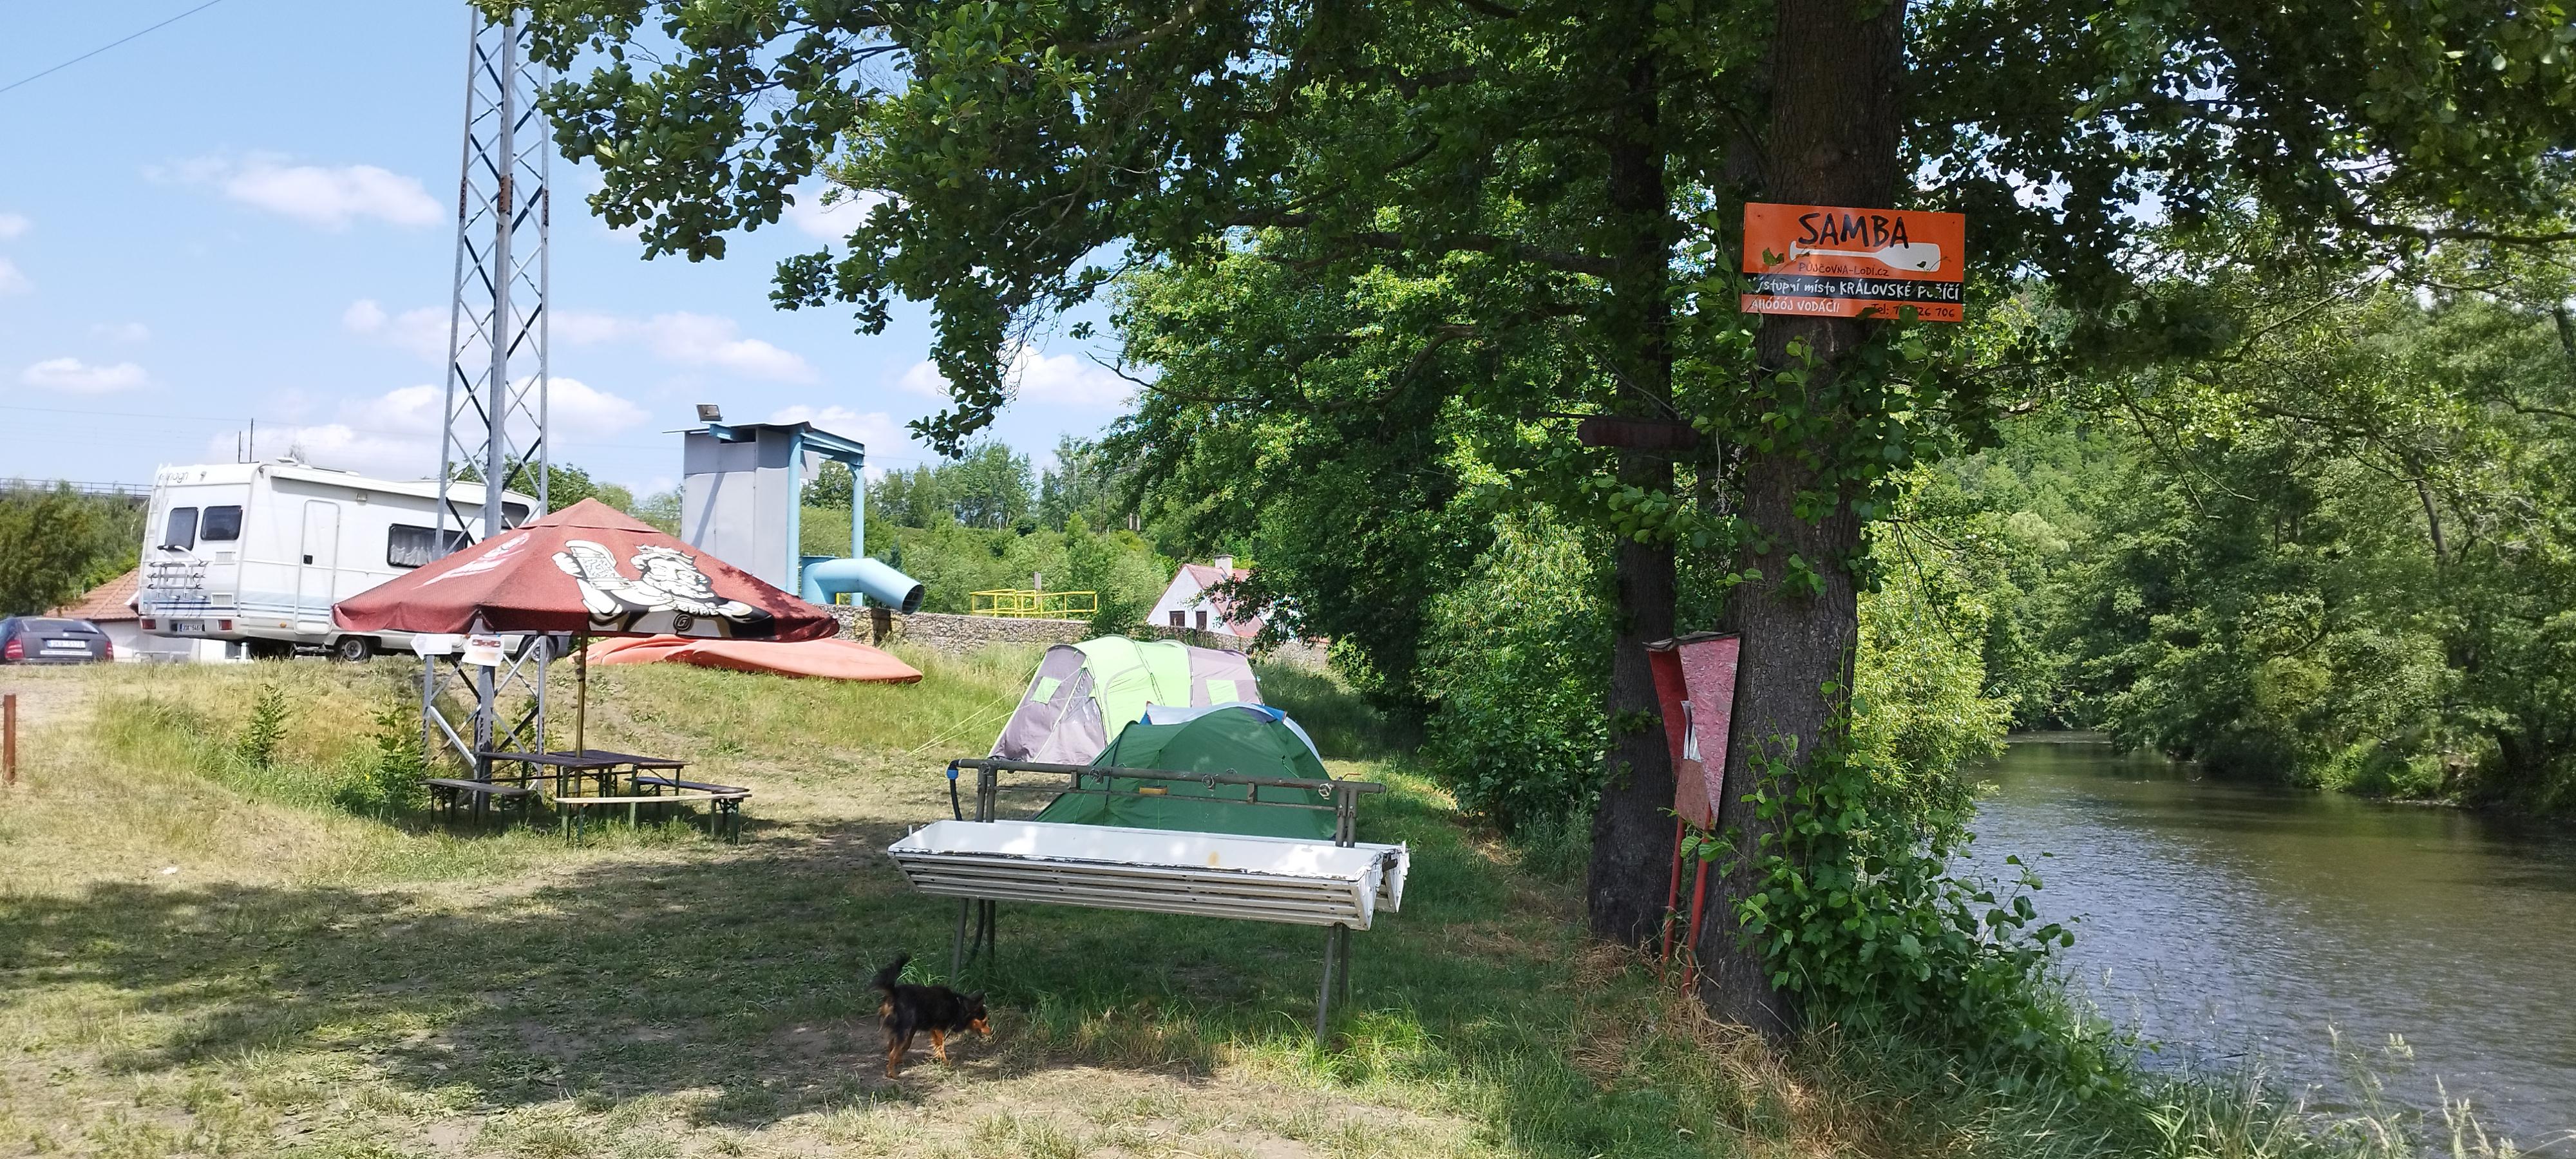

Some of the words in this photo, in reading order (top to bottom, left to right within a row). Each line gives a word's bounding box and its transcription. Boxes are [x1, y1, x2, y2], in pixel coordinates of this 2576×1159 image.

[1798, 212, 1909, 249] SAMBA
[1804, 279, 1835, 295] místo
[1839, 278, 1911, 298] KRÁLOVSKÉ
[1915, 306, 1931, 316] 26
[1935, 307, 1955, 317] 706
